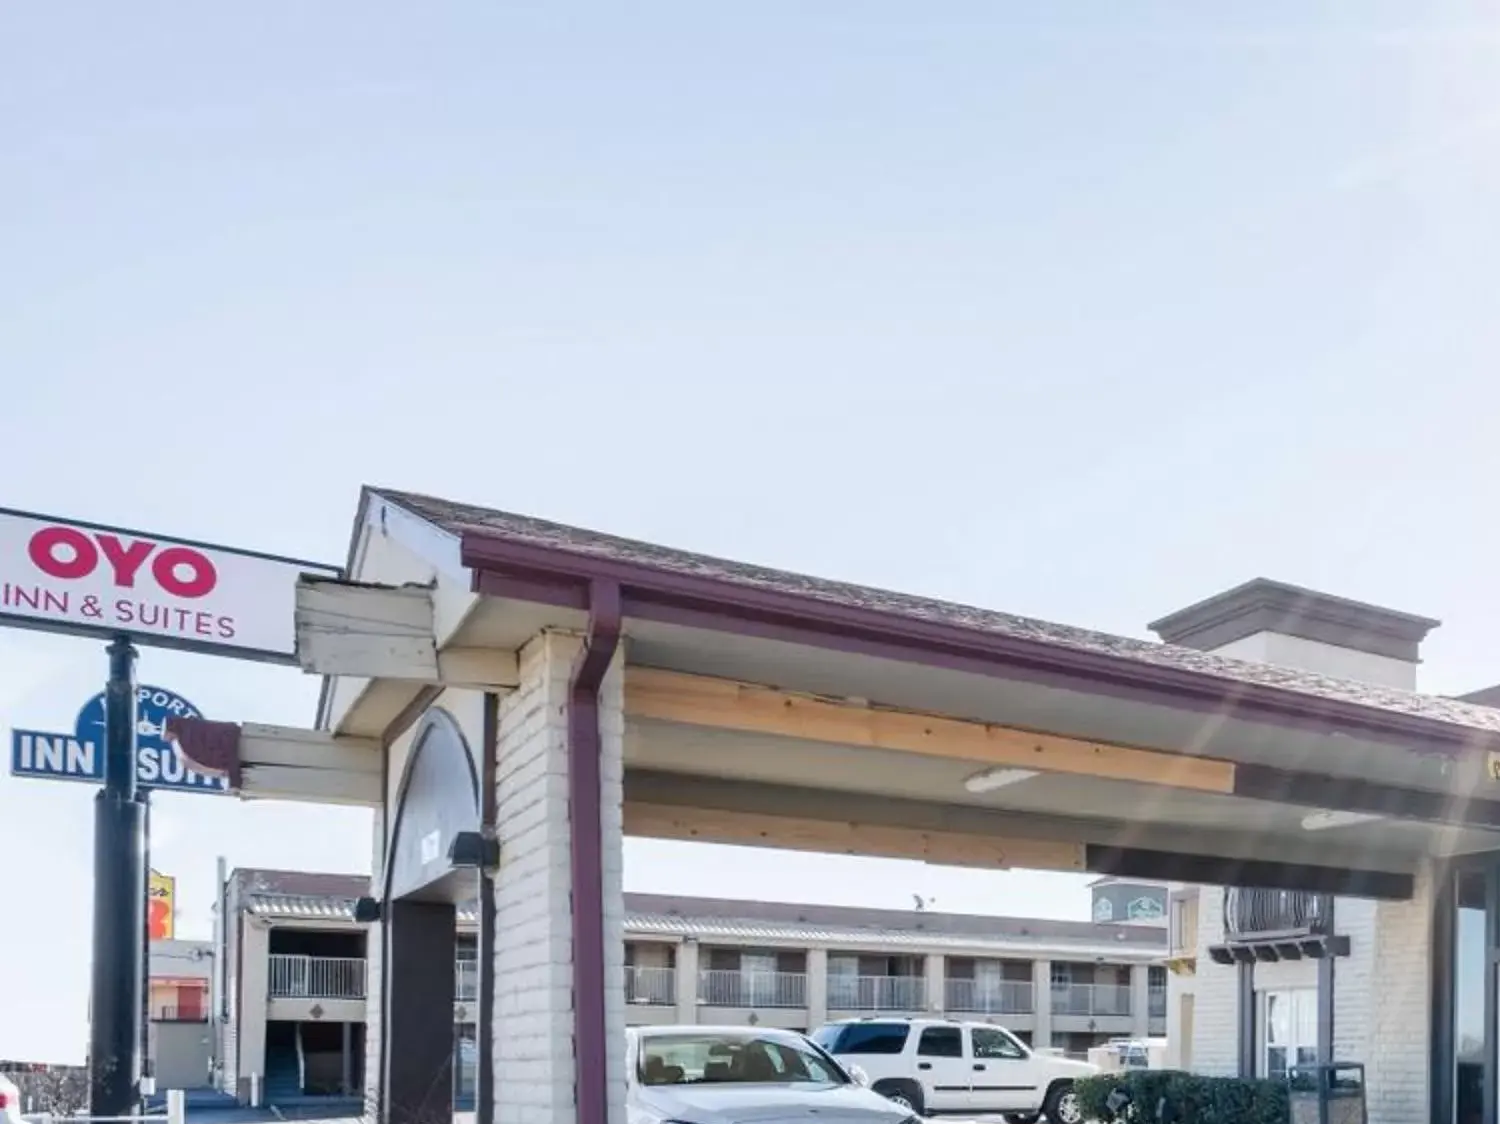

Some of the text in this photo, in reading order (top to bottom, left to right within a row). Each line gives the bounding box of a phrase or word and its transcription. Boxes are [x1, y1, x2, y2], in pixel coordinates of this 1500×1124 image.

[28, 526, 217, 598] OYO
[3, 583, 235, 638] INN & SUITES
[20, 735, 95, 775] INN
